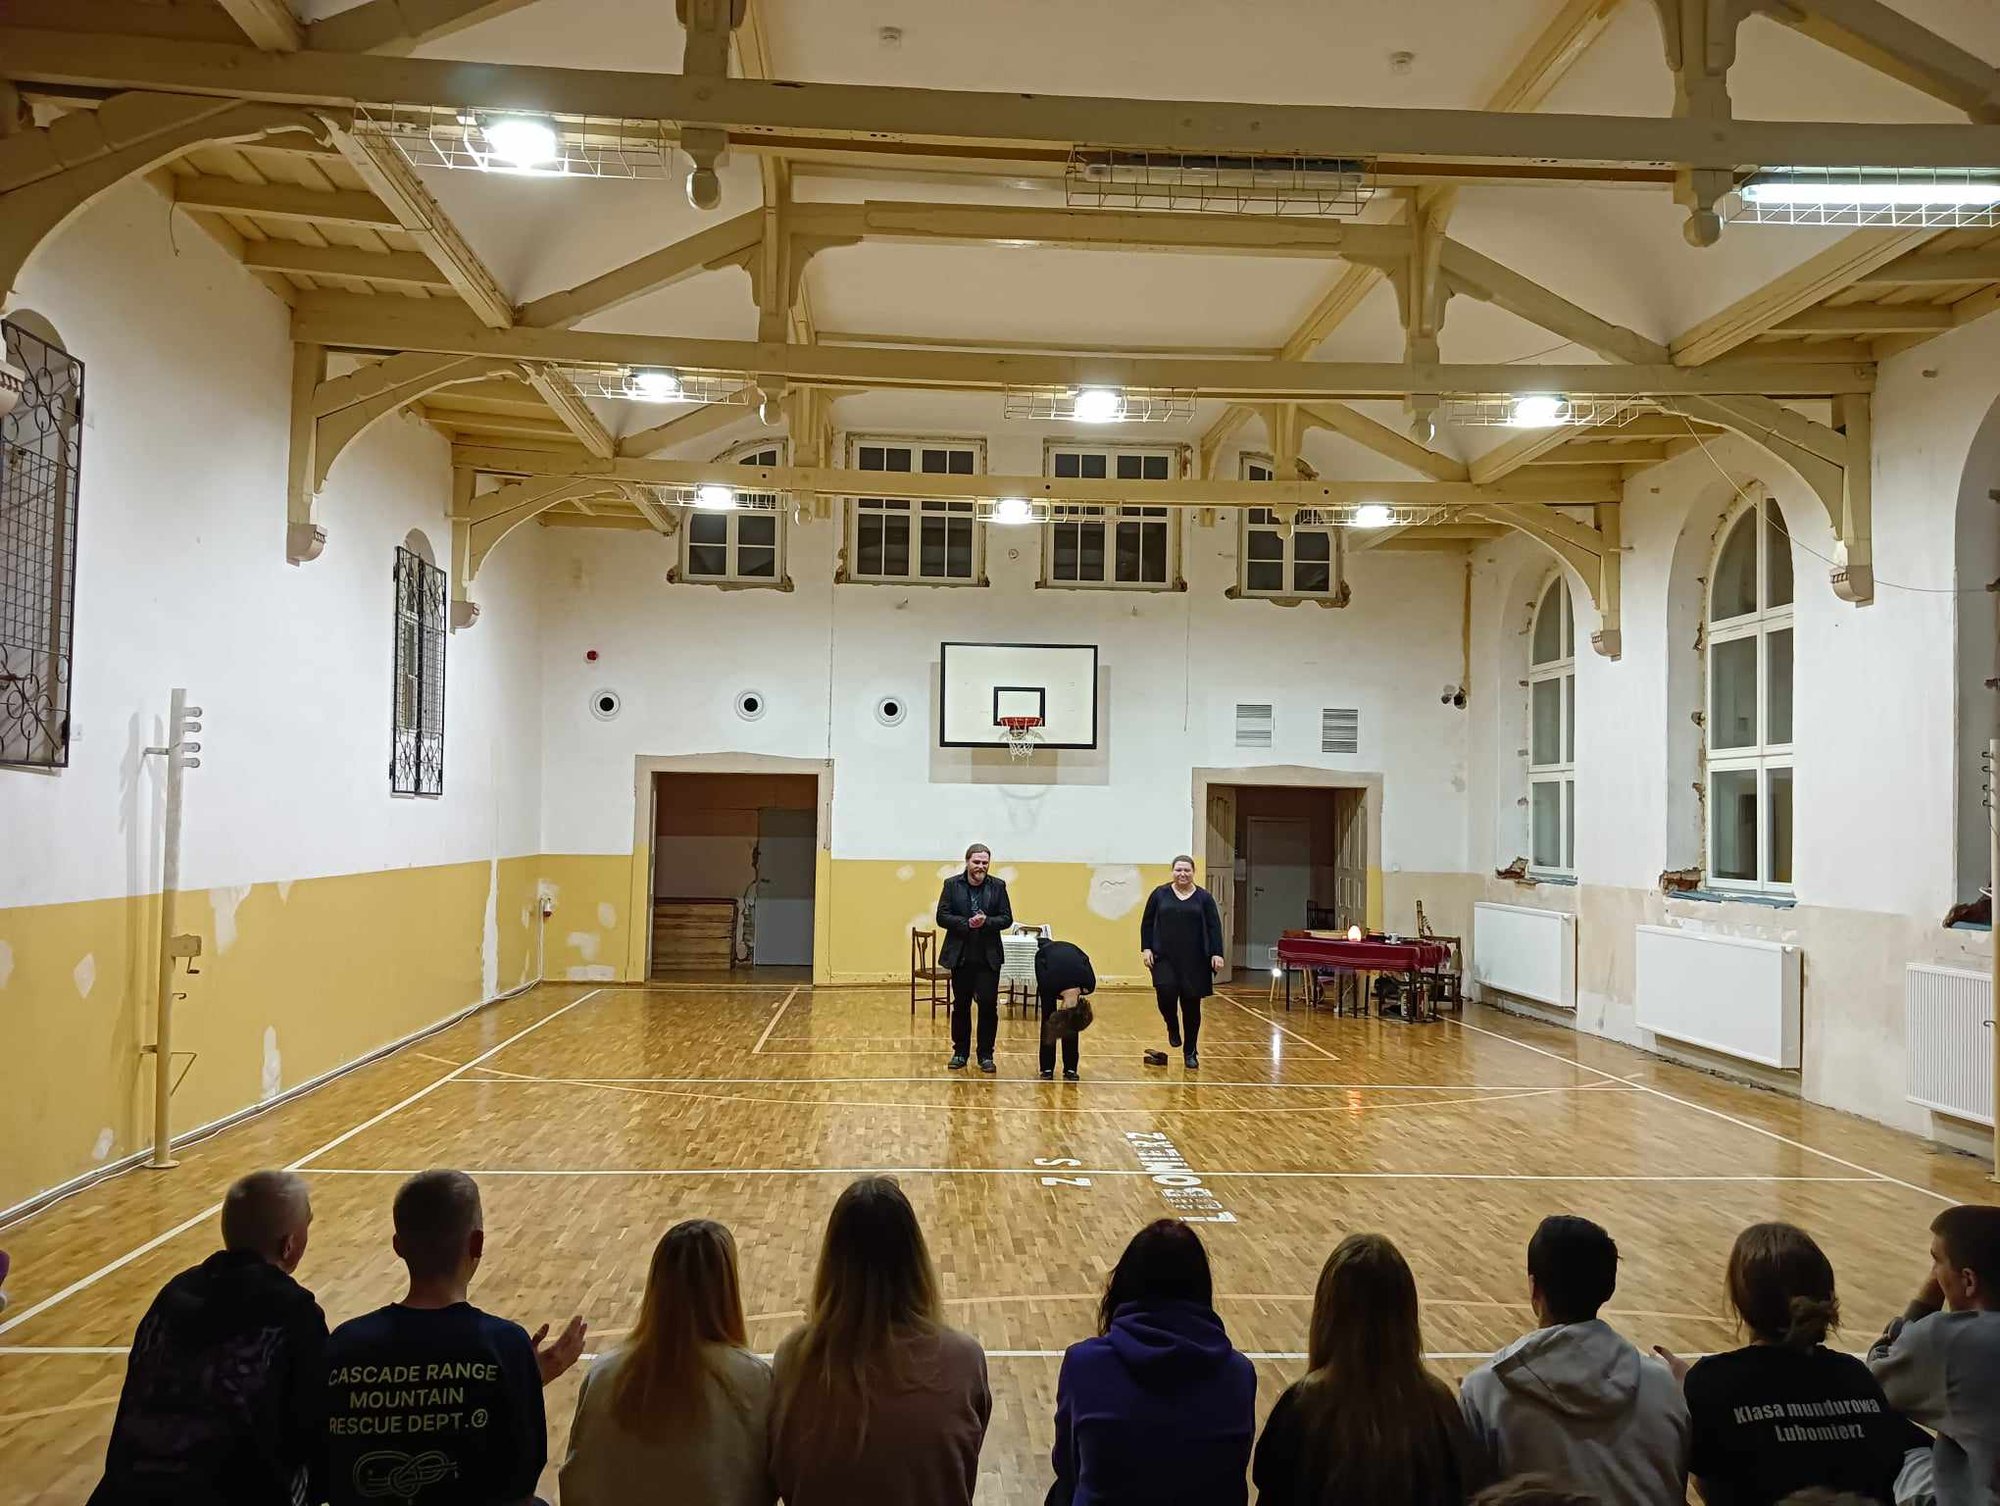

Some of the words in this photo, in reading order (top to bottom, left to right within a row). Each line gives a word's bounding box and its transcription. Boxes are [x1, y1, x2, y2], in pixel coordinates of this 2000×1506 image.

[328, 1366, 420, 1386] CASCADE
[426, 1362, 498, 1381] RANGE
[350, 1387, 464, 1409] MOUNTAIN
[1733, 1403, 1784, 1424] Klasa
[1787, 1398, 1881, 1417] mundurowa
[329, 1415, 402, 1435] RESCUE
[1775, 1423, 1865, 1442] Lubomierz
